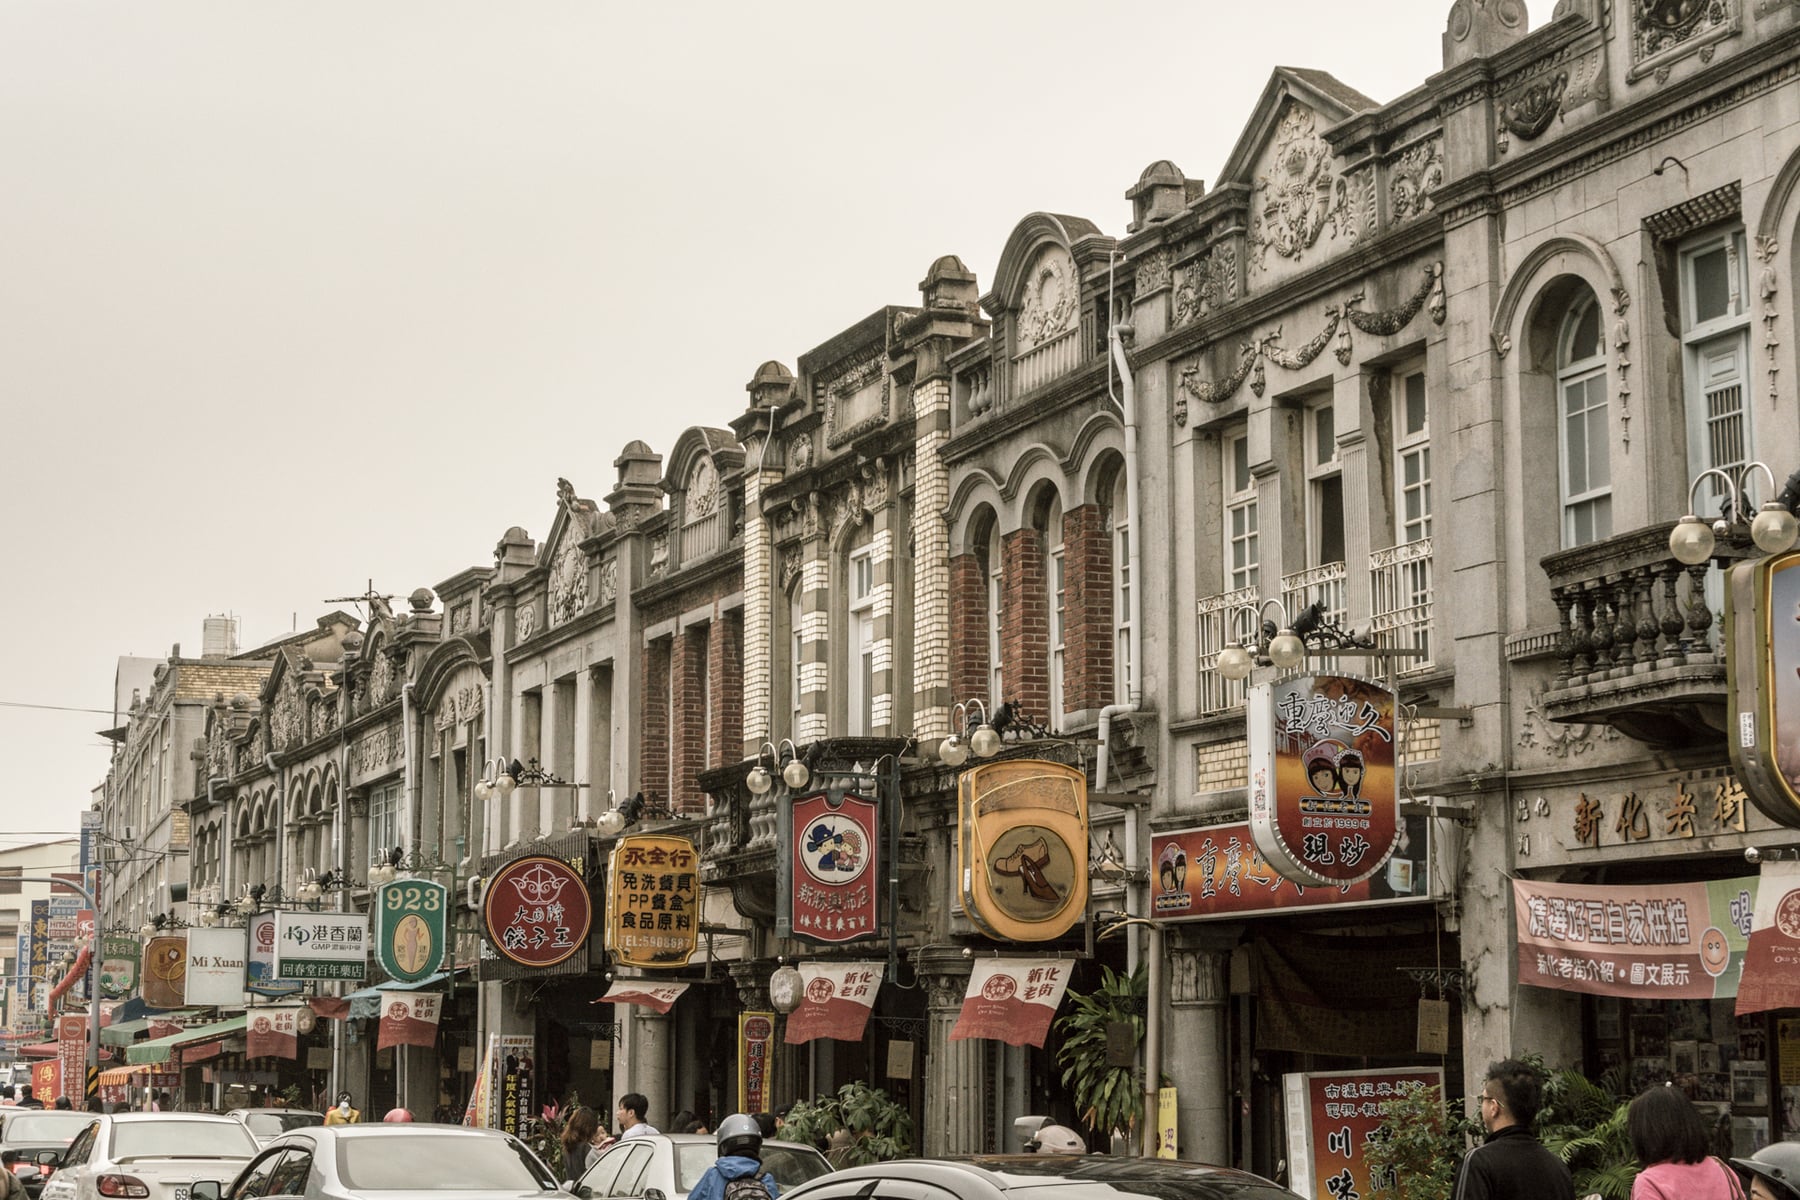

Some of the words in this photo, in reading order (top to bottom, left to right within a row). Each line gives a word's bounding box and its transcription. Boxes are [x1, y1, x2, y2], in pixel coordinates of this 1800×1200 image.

[1278, 692, 1391, 742] 重慶迎久
[1574, 777, 1748, 848] 新化老街
[1302, 817, 1370, 830] 創立於1999年
[624, 846, 691, 868] 永全行
[1303, 833, 1370, 867] 現炒
[623, 872, 692, 893] 免洗餐具
[387, 887, 440, 911] 923
[629, 893, 684, 911] PP餐盒
[621, 911, 690, 931] 食品原料
[1527, 894, 1691, 945] 精選好豆自家烘焙
[312, 925, 362, 942] 港香蘭
[503, 926, 574, 950] 餃子王
[192, 956, 208, 967] Mi
[212, 957, 244, 968] Xuan
[282, 963, 363, 977] 回春堂百年藥店
[844, 971, 873, 984] 新化
[1027, 967, 1060, 984] 新化
[840, 984, 869, 997] 老街
[1024, 983, 1055, 1000] 老街
